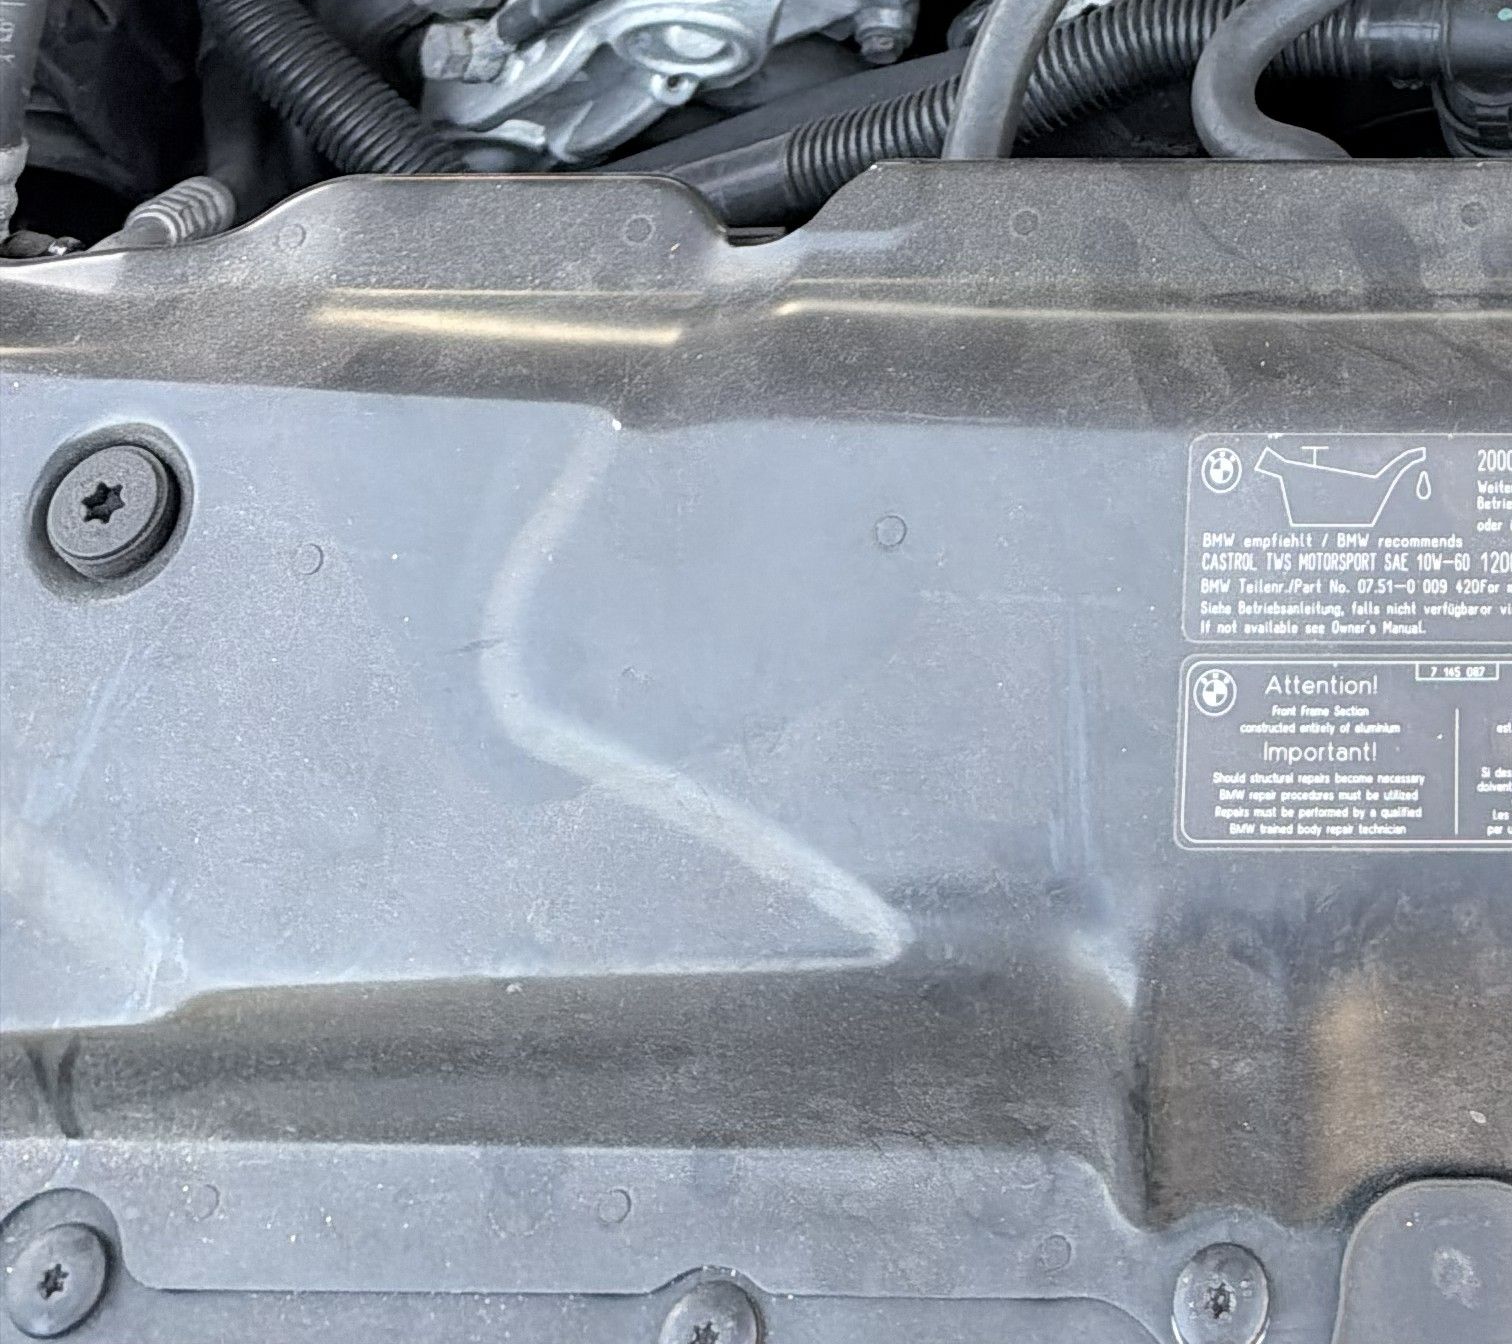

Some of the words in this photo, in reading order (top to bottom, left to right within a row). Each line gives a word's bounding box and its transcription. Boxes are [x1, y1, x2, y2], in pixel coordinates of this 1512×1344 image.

[1477, 518, 1503, 532] oder
[1203, 533, 1234, 547] BMW
[1244, 533, 1312, 550] empfiehlt
[1322, 533, 1328, 547] /
[1337, 533, 1369, 547] BMW
[1378, 534, 1463, 548] recommends
[1202, 552, 1257, 571] CASTROL
[1267, 552, 1291, 570] TWS
[1299, 553, 1377, 571] MOTORSPORT
[1384, 553, 1408, 571] SAE
[1417, 553, 1470, 571] 10W-60
[1201, 578, 1230, 593] BMW
[1330, 579, 1350, 593] No.
[1423, 579, 1447, 594] 009
[1201, 601, 1231, 614] Siehe
[1238, 601, 1344, 617] Betriebsanleitung,
[1352, 601, 1380, 615] falls
[1387, 601, 1416, 615] nicht
[1201, 620, 1210, 634] If
[1217, 620, 1237, 633] not
[1244, 620, 1298, 634] available
[1305, 624, 1325, 634] see
[1332, 620, 1376, 634] Owner's
[1383, 620, 1426, 634] Manual.
[1430, 666, 1437, 678] 7
[1265, 675, 1377, 695] Attention!
[1272, 705, 1296, 716] Front
[1301, 705, 1329, 717] Frame
[1334, 705, 1369, 717] Section
[1240, 722, 1295, 733] constructed
[1300, 722, 1335, 735] entirely
[1340, 722, 1350, 733] of
[1496, 722, 1512, 733] est
[1264, 741, 1376, 765] Important!
[1213, 772, 1246, 783] Should
[1298, 773, 1330, 785] repairs
[1335, 773, 1373, 783] become
[1377, 775, 1425, 785] necessary
[1481, 767, 1490, 778] Si
[1495, 767, 1512, 778] des
[1220, 789, 1245, 800] BMW
[1249, 790, 1276, 802] repair
[1281, 790, 1334, 802] procedures
[1339, 790, 1361, 801] must
[1366, 790, 1379, 800] be
[1215, 806, 1249, 819] Repairs
[1254, 807, 1276, 817] must
[1281, 806, 1294, 817] be
[1298, 807, 1348, 819] performed
[1353, 807, 1365, 820] by
[1370, 809, 1376, 817] a
[1381, 807, 1422, 819] qualified
[1492, 809, 1509, 820] Les
[1230, 823, 1255, 835] BMW
[1260, 823, 1293, 834] trained
[1297, 823, 1322, 837] body
[1326, 824, 1354, 836] repair
[1487, 826, 1503, 836] par
